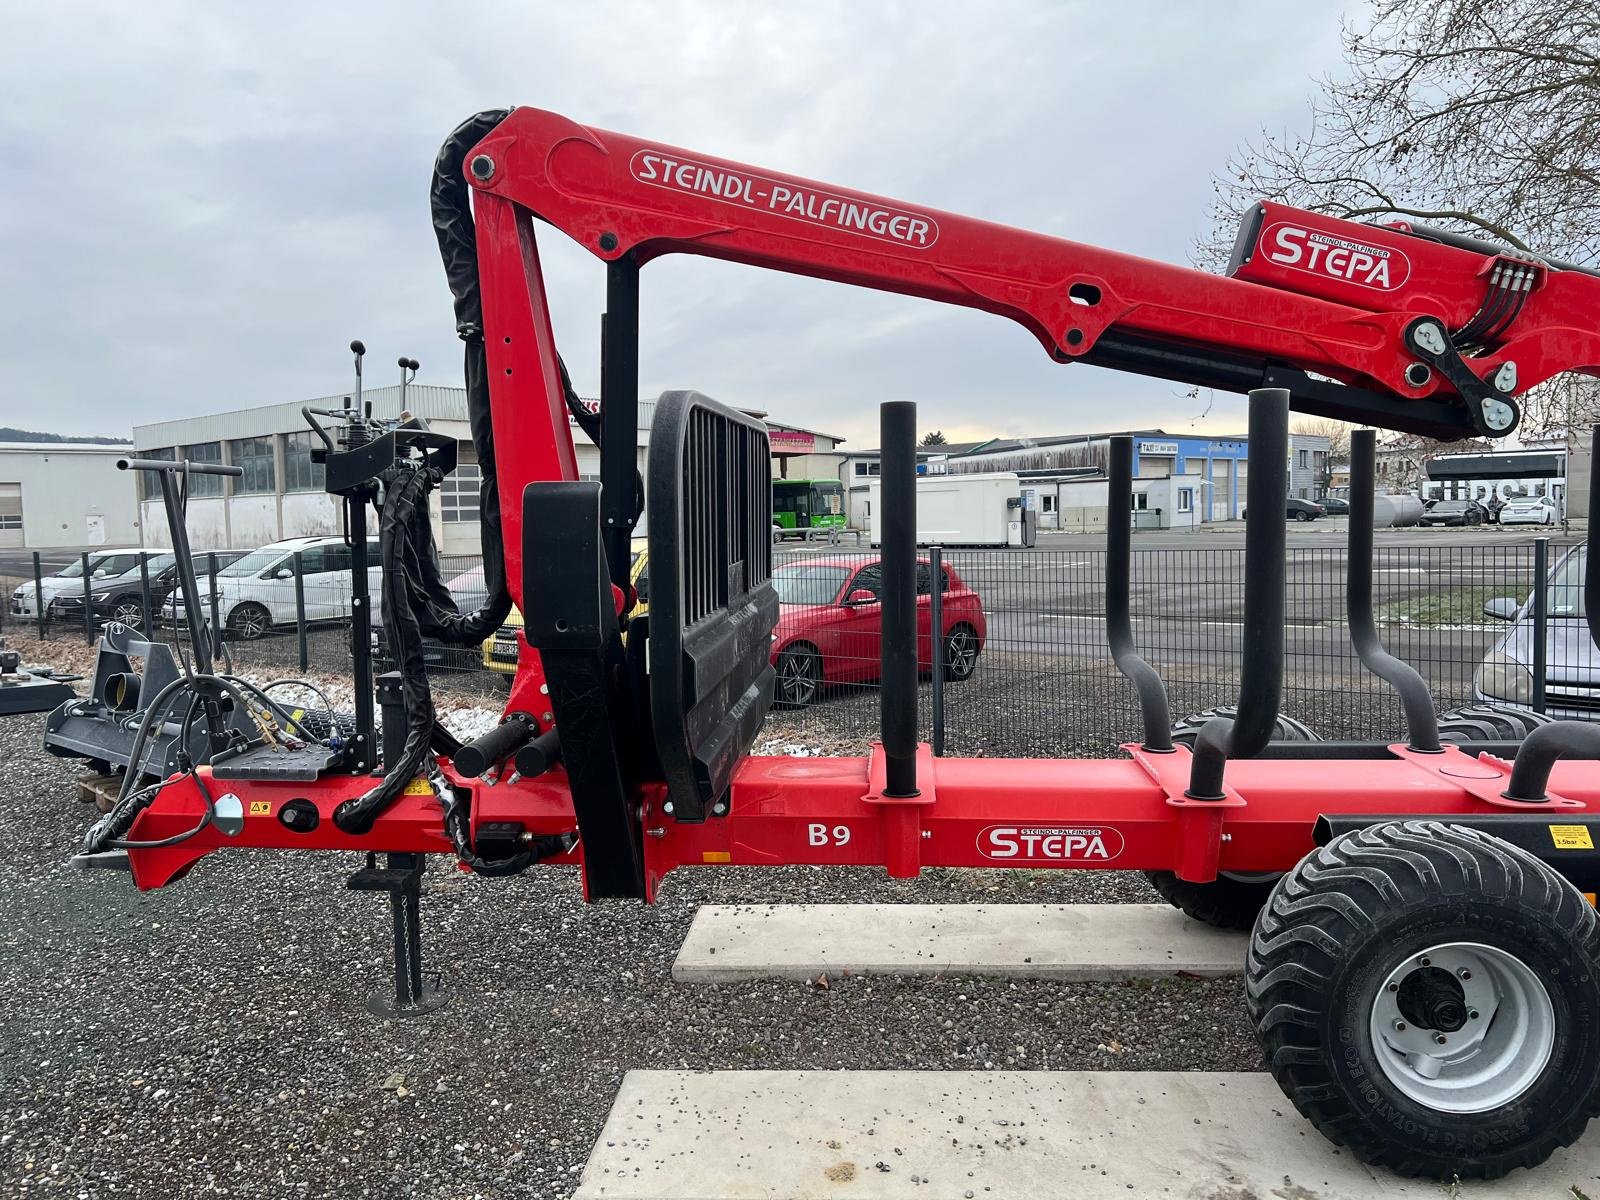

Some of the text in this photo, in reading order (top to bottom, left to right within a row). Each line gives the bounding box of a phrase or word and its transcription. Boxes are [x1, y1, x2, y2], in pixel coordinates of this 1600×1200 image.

[638, 155, 930, 245] STEINDL-PALFINGER
[1271, 226, 1391, 289] STEPA
[1311, 233, 1389, 258] STEINDL-PALFINGER
[989, 828, 1109, 858] STEPA
[1022, 828, 1100, 836] STEINDL-PALFINGER
